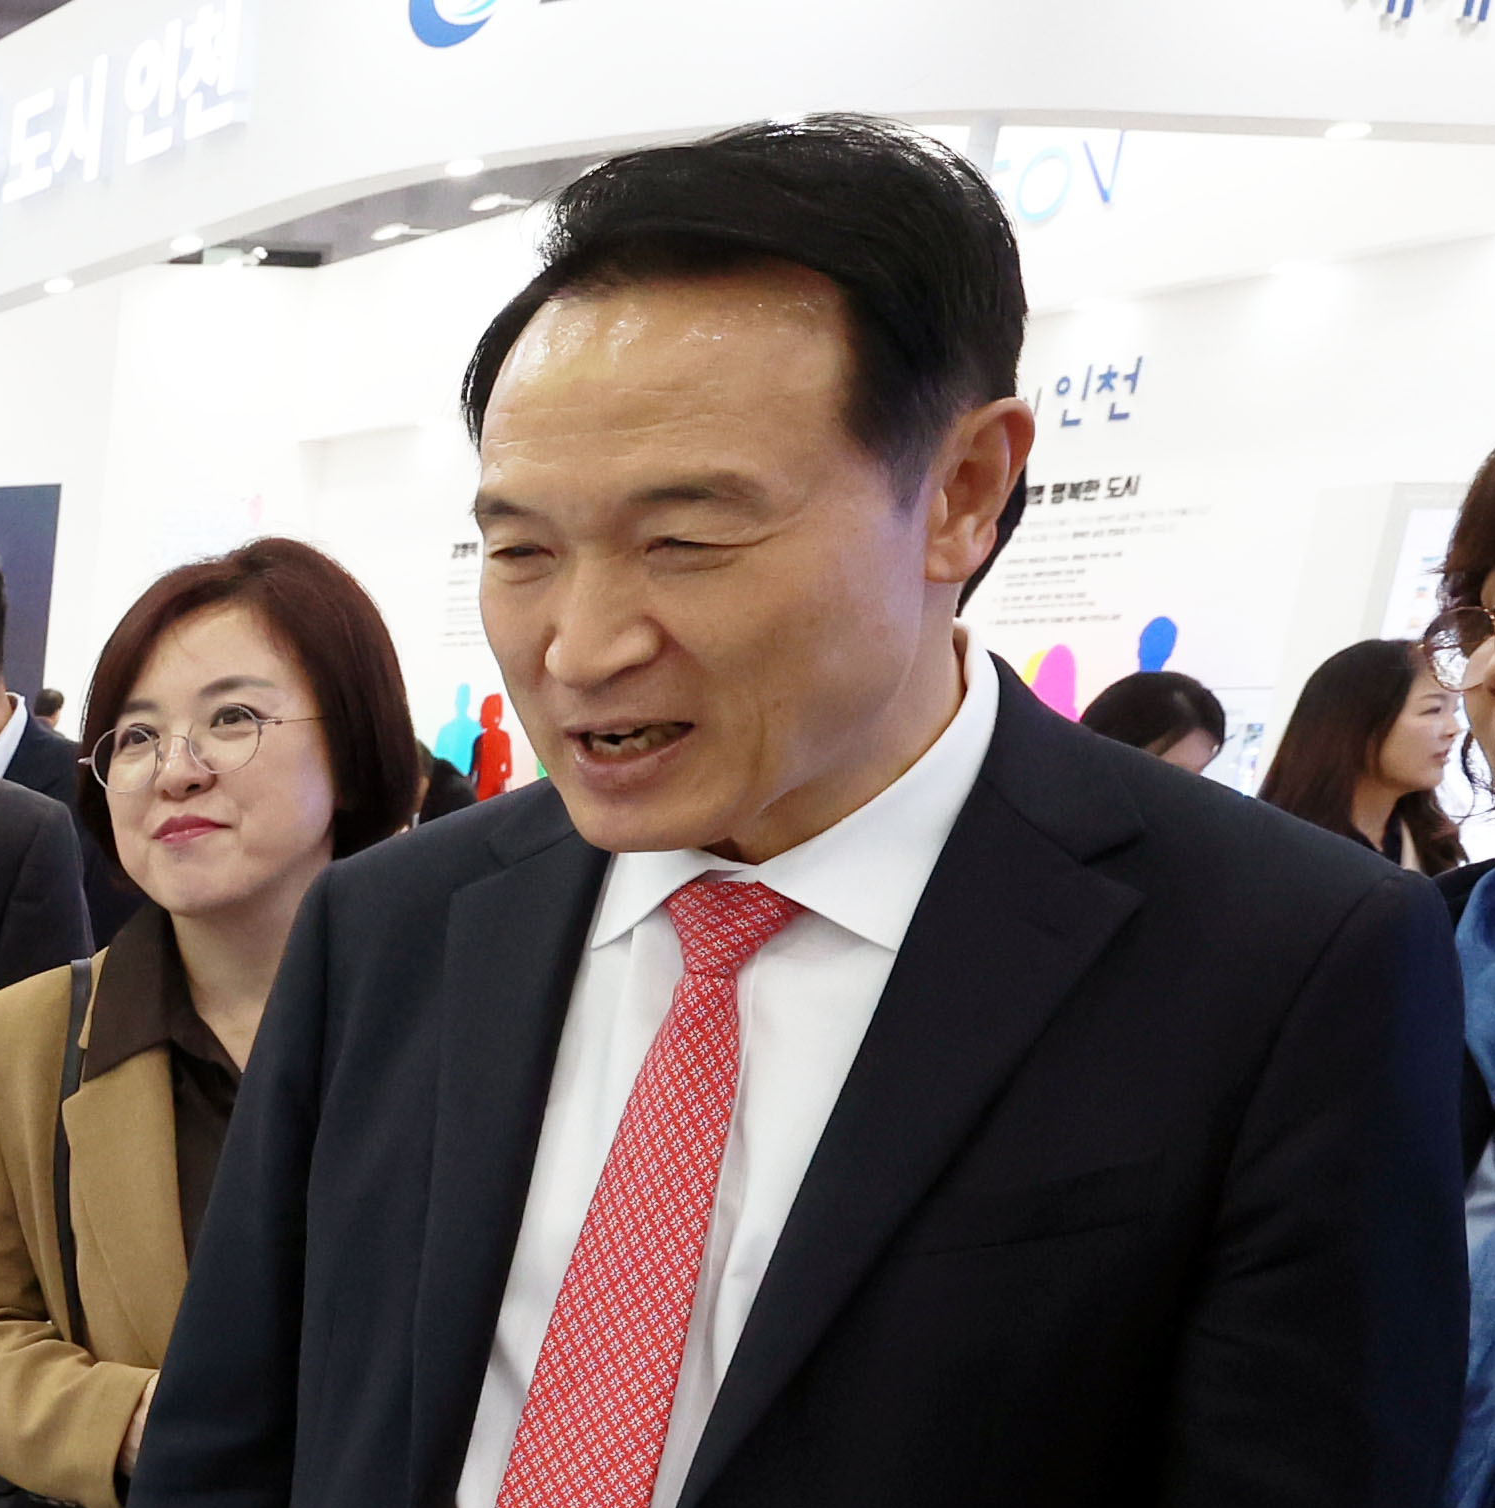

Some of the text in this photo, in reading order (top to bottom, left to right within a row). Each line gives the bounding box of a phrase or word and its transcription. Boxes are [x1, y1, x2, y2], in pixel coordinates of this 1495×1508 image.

[3, 54, 109, 204] 도시
[123, 0, 245, 166] 인천
[1056, 356, 1143, 428] 인천
[1105, 475, 1140, 499] 도시
